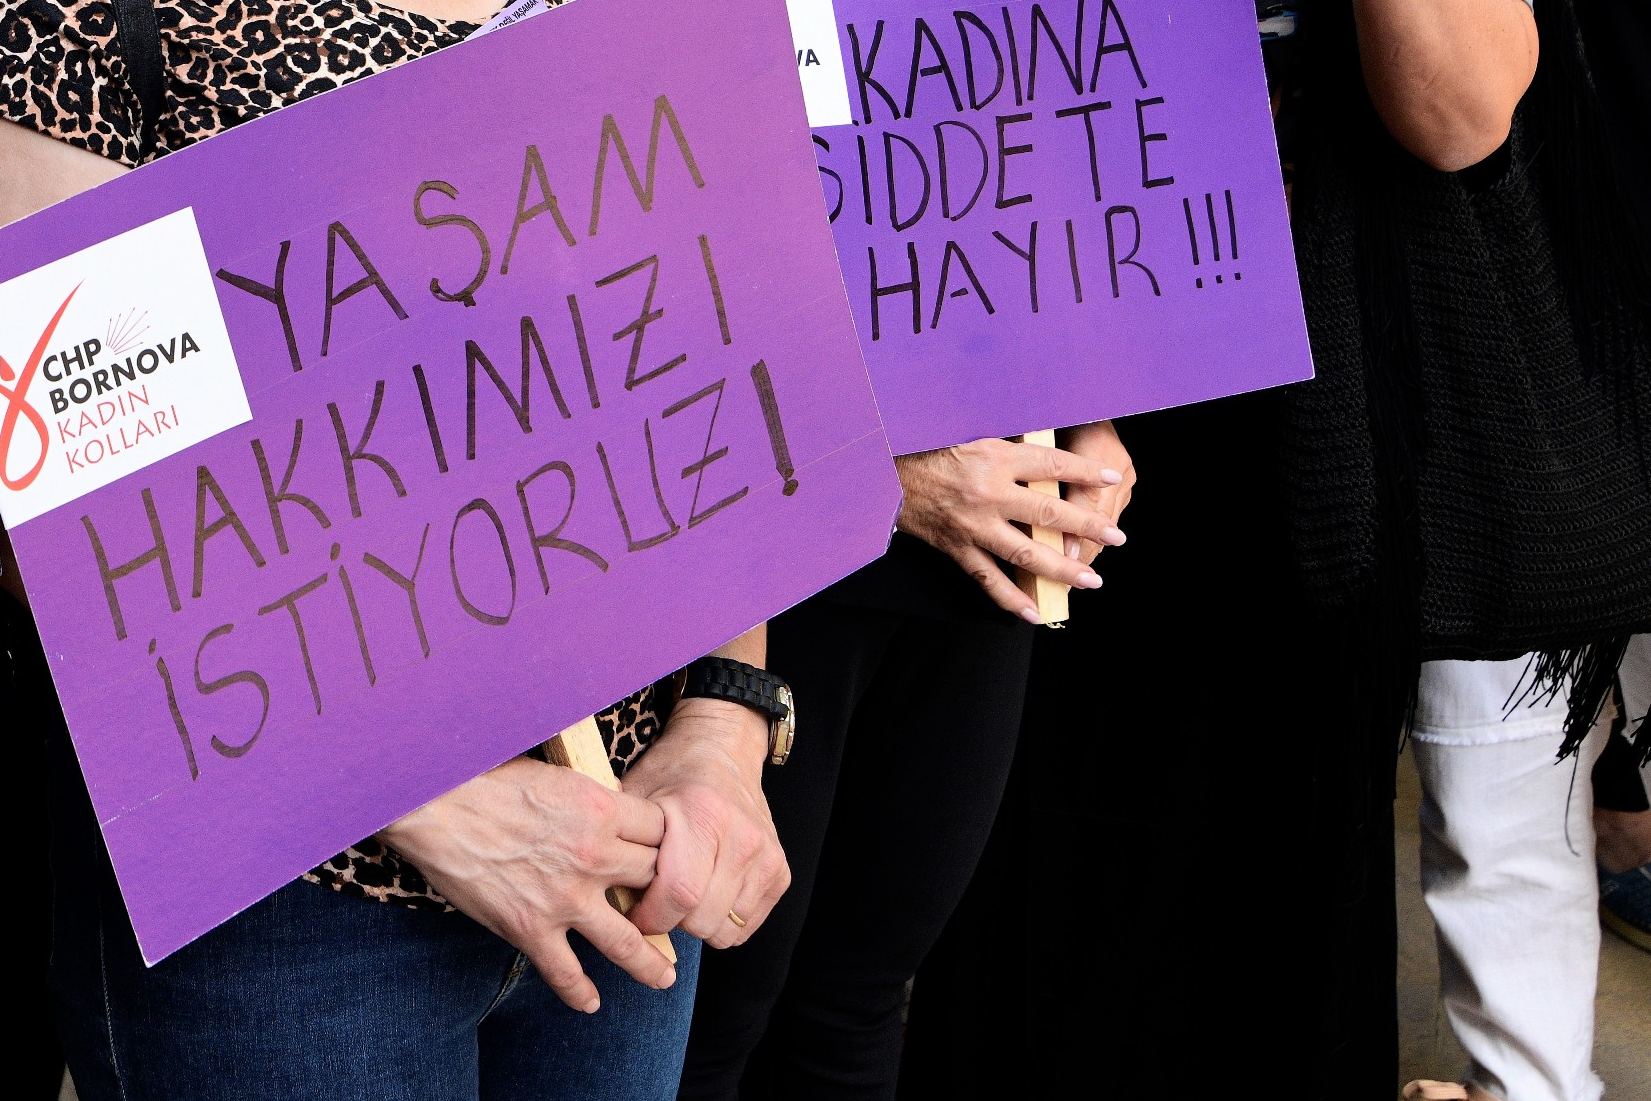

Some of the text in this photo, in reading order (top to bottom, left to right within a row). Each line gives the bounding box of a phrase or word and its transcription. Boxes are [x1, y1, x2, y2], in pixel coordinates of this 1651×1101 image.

[216, 93, 705, 372] YAŞAM
[42, 338, 102, 383] CHP
[49, 332, 201, 415] BORNOVA
[57, 384, 150, 444] KADIN
[65, 404, 179, 474] KOLLARI
[79, 233, 731, 642] HAKKIMIZI
